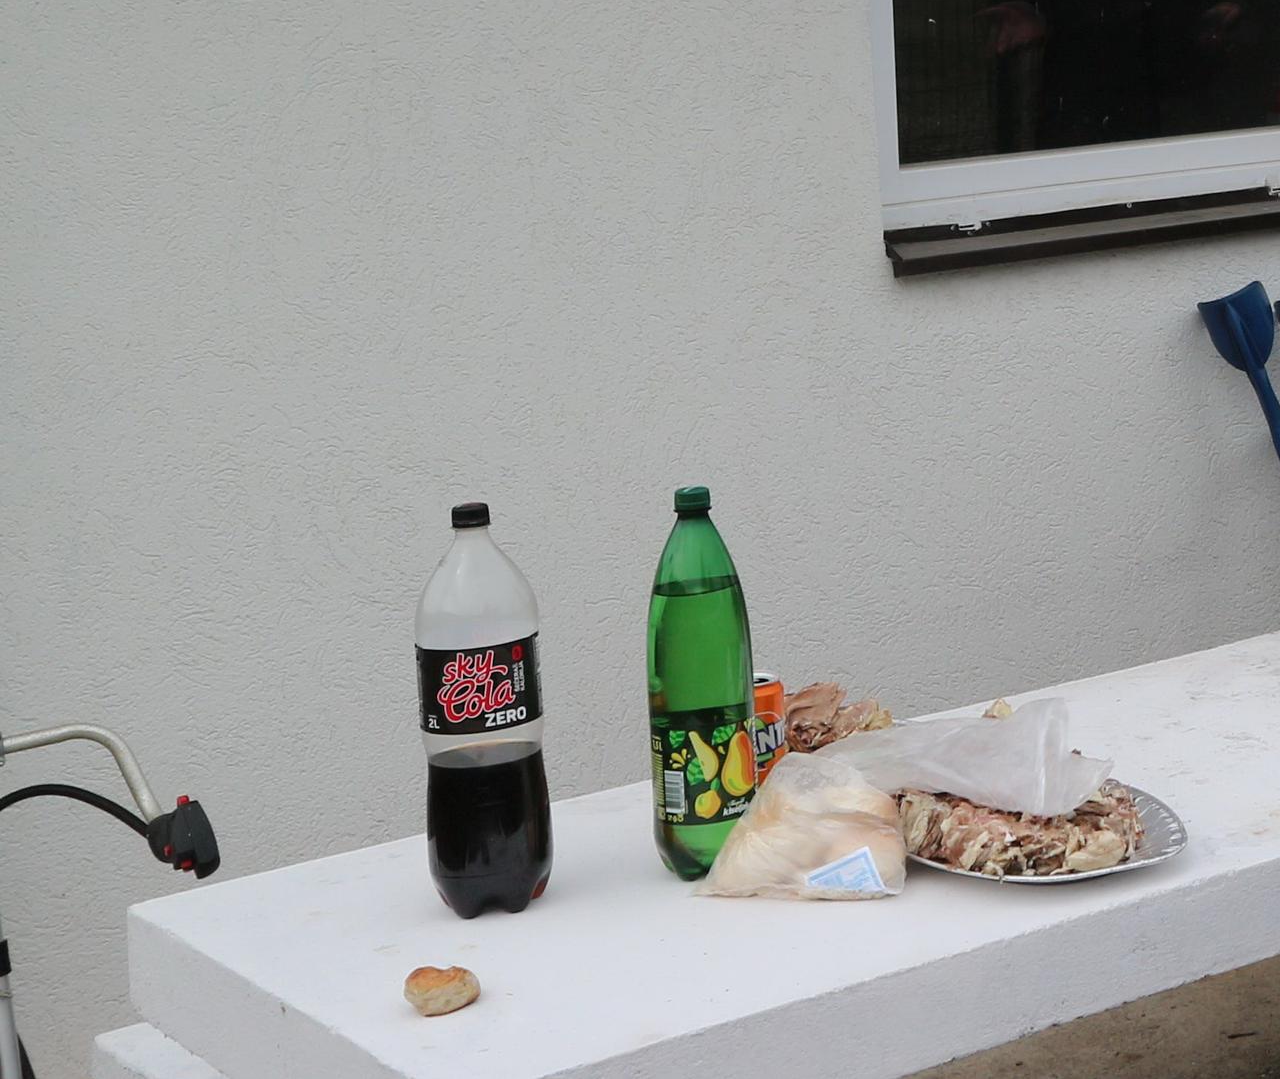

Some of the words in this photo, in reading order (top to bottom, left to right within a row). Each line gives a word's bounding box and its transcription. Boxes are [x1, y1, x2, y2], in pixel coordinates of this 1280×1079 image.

[442, 650, 508, 684] sky
[437, 679, 516, 723] Cola
[428, 718, 440, 729] 2L
[484, 706, 527, 727] ZERO
